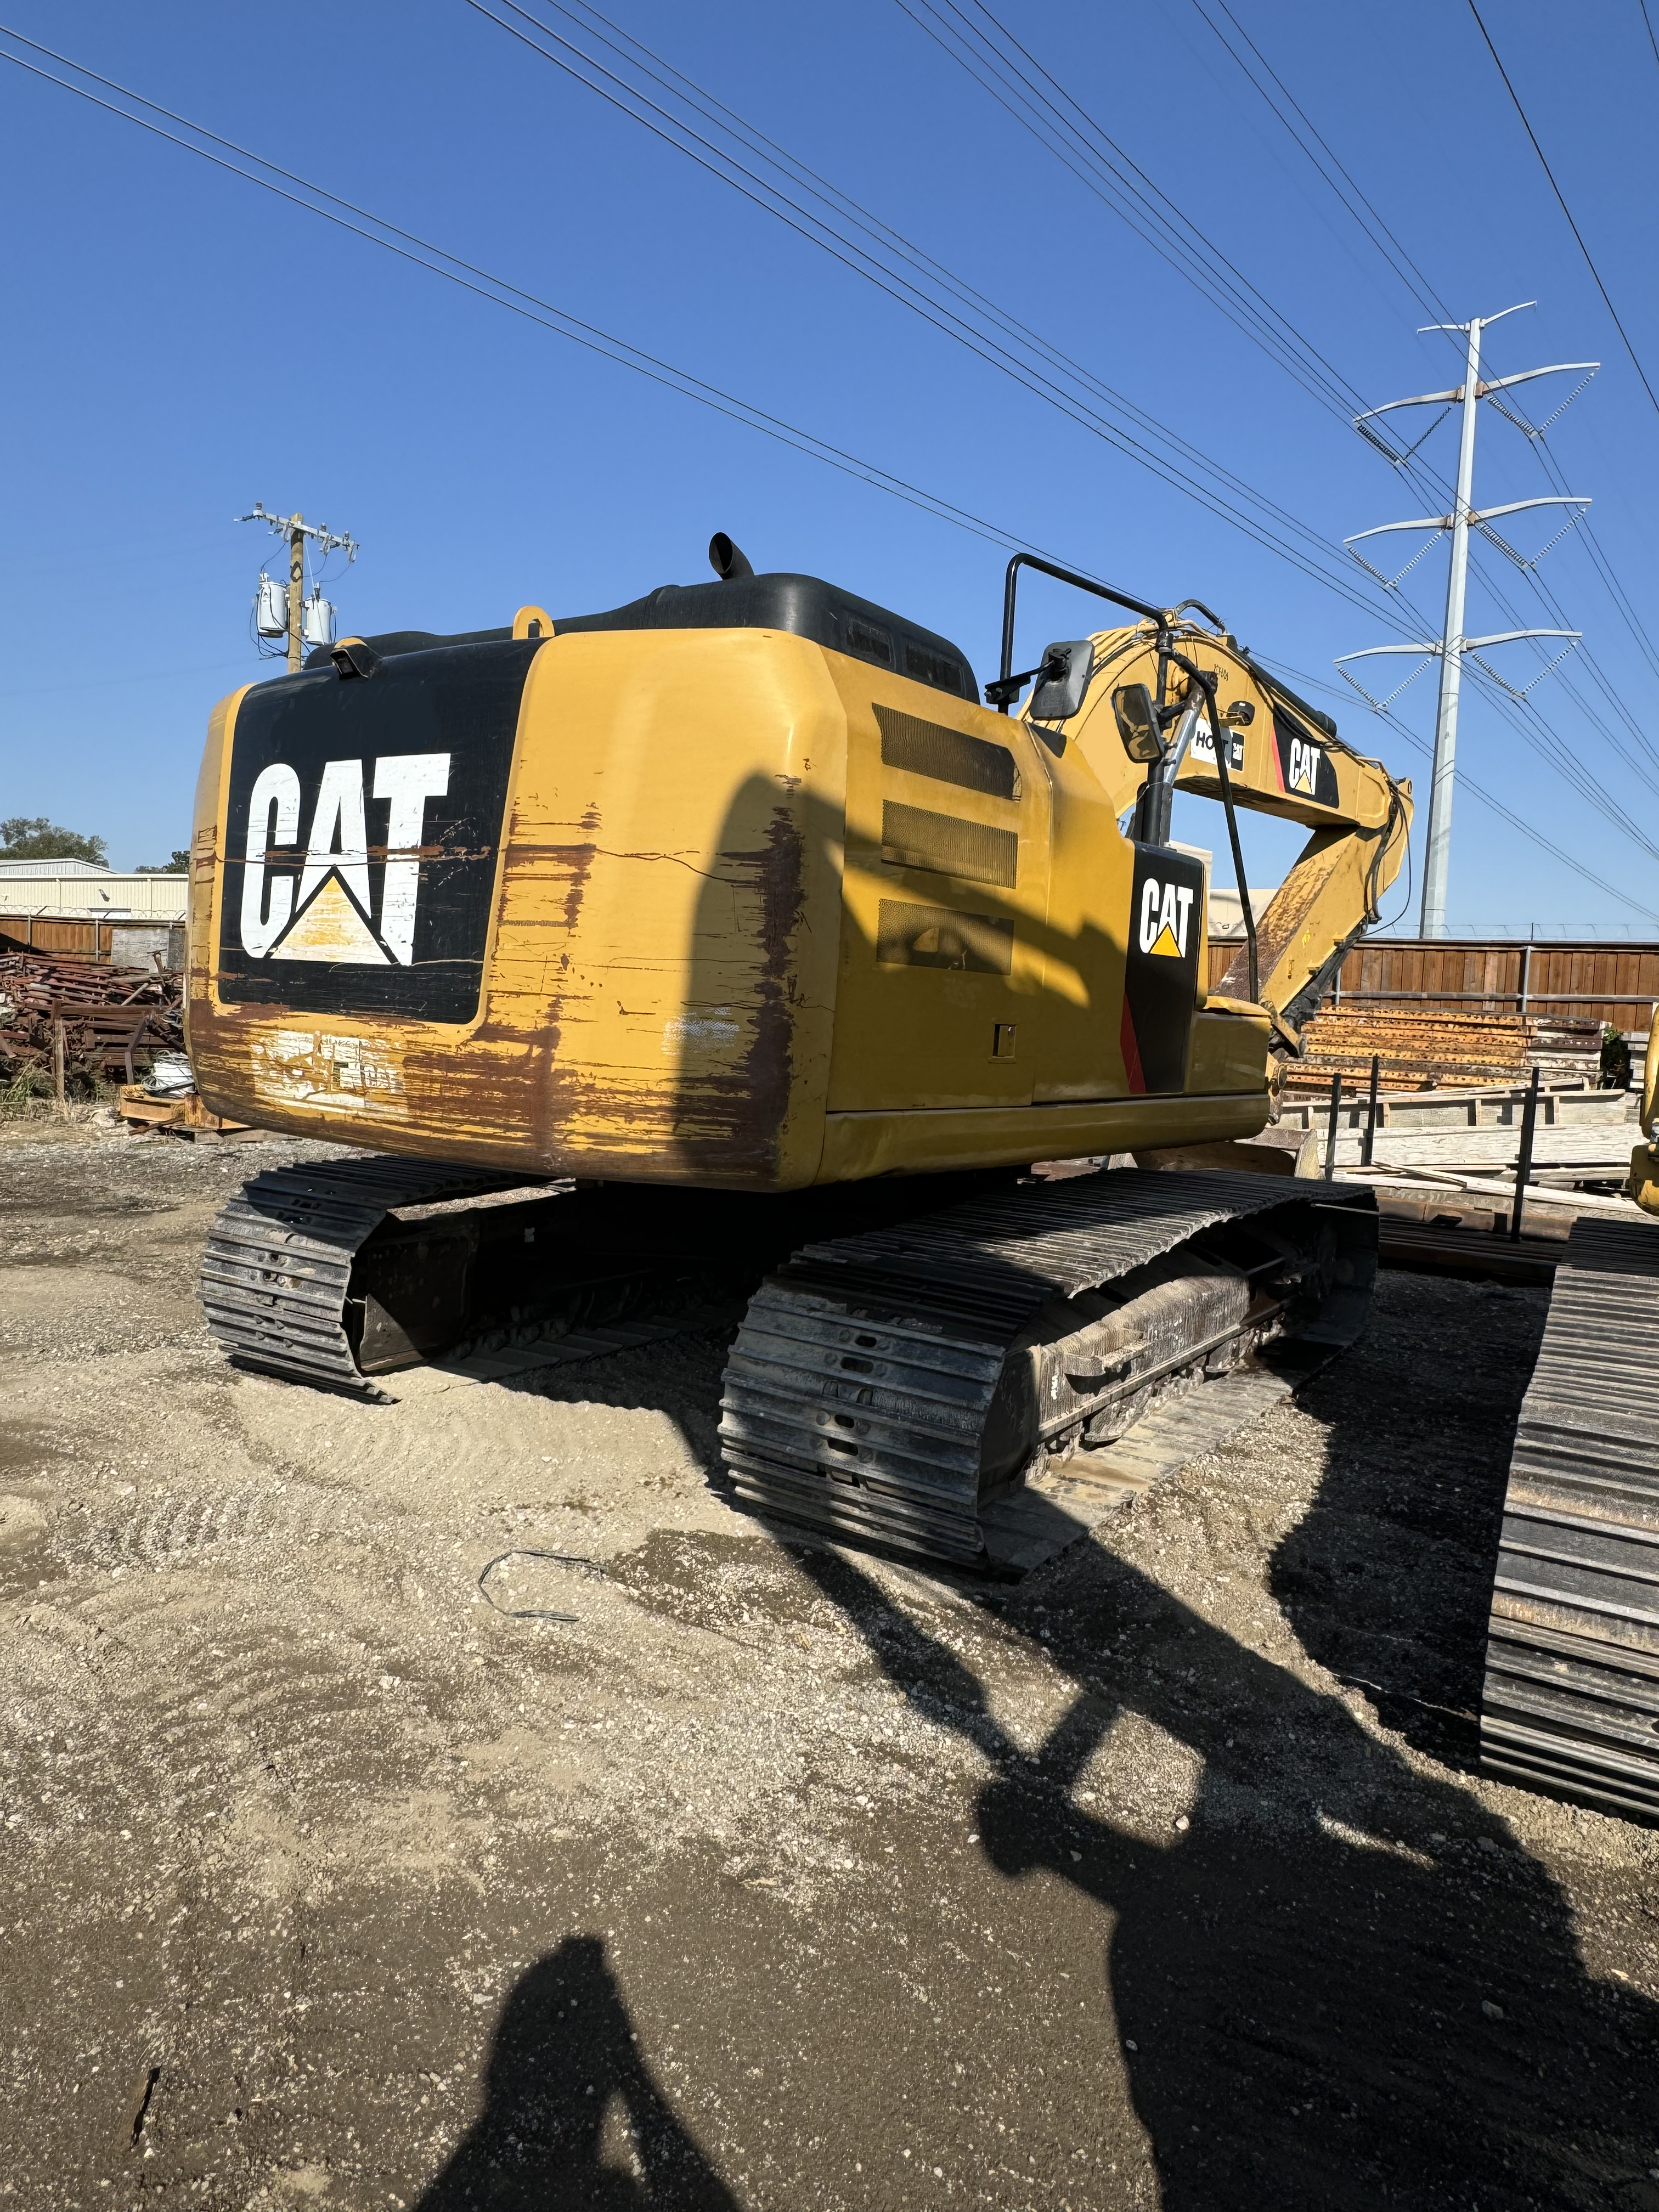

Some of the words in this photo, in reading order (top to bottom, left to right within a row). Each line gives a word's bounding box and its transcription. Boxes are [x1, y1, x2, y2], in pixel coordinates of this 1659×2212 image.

[1289, 738, 1321, 795] CAT
[240, 753, 450, 967] CAT
[1139, 878, 1194, 958] CAT
